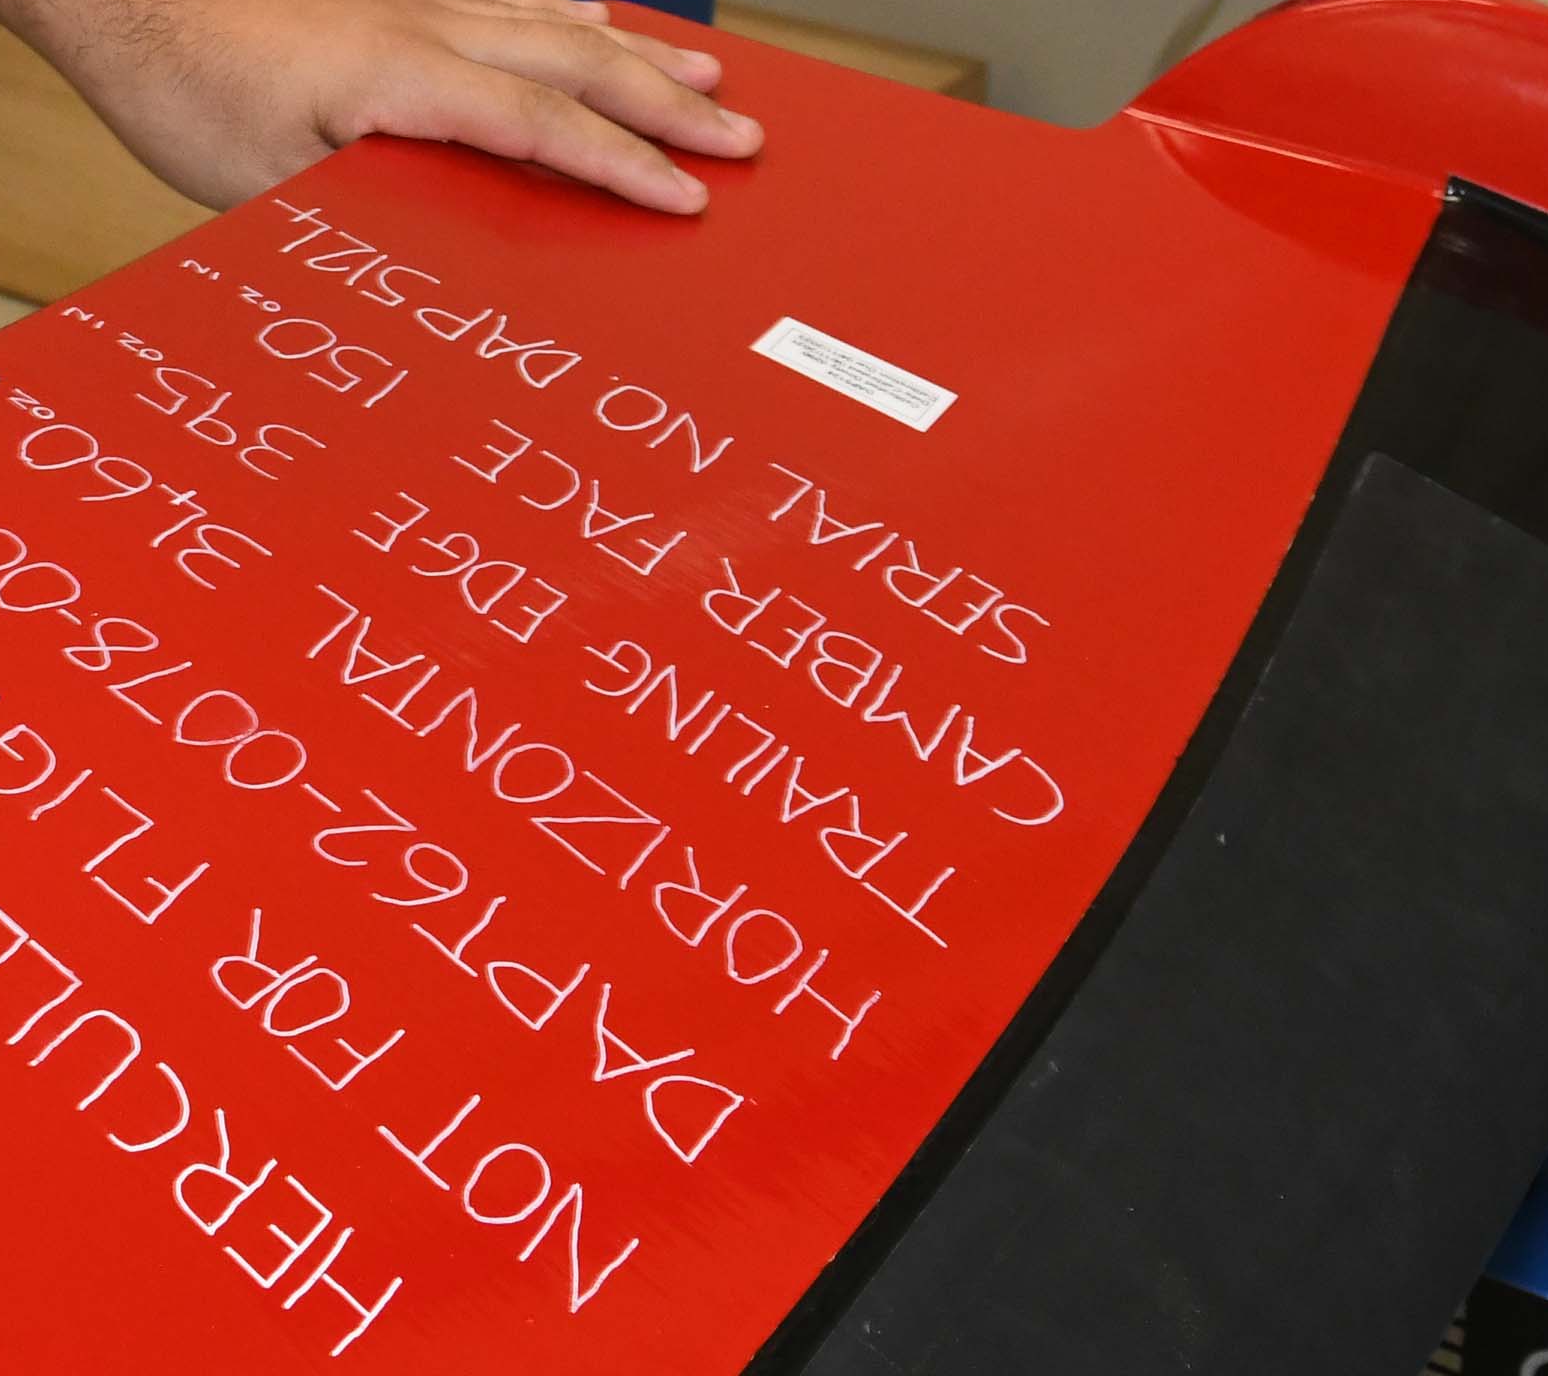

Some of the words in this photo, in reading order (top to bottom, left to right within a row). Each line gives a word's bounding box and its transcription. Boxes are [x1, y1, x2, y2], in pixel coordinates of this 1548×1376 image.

[353, 492, 568, 643] EDGE
[451, 419, 687, 575] FACE
[769, 463, 1050, 663] SERIAL
[584, 641, 955, 948] TRAILING
[702, 558, 1064, 825] CAMBER
[307, 585, 881, 1060] HORIZONTAL
[211, 908, 405, 1091] FOR
[377, 1094, 639, 1313] NOT
